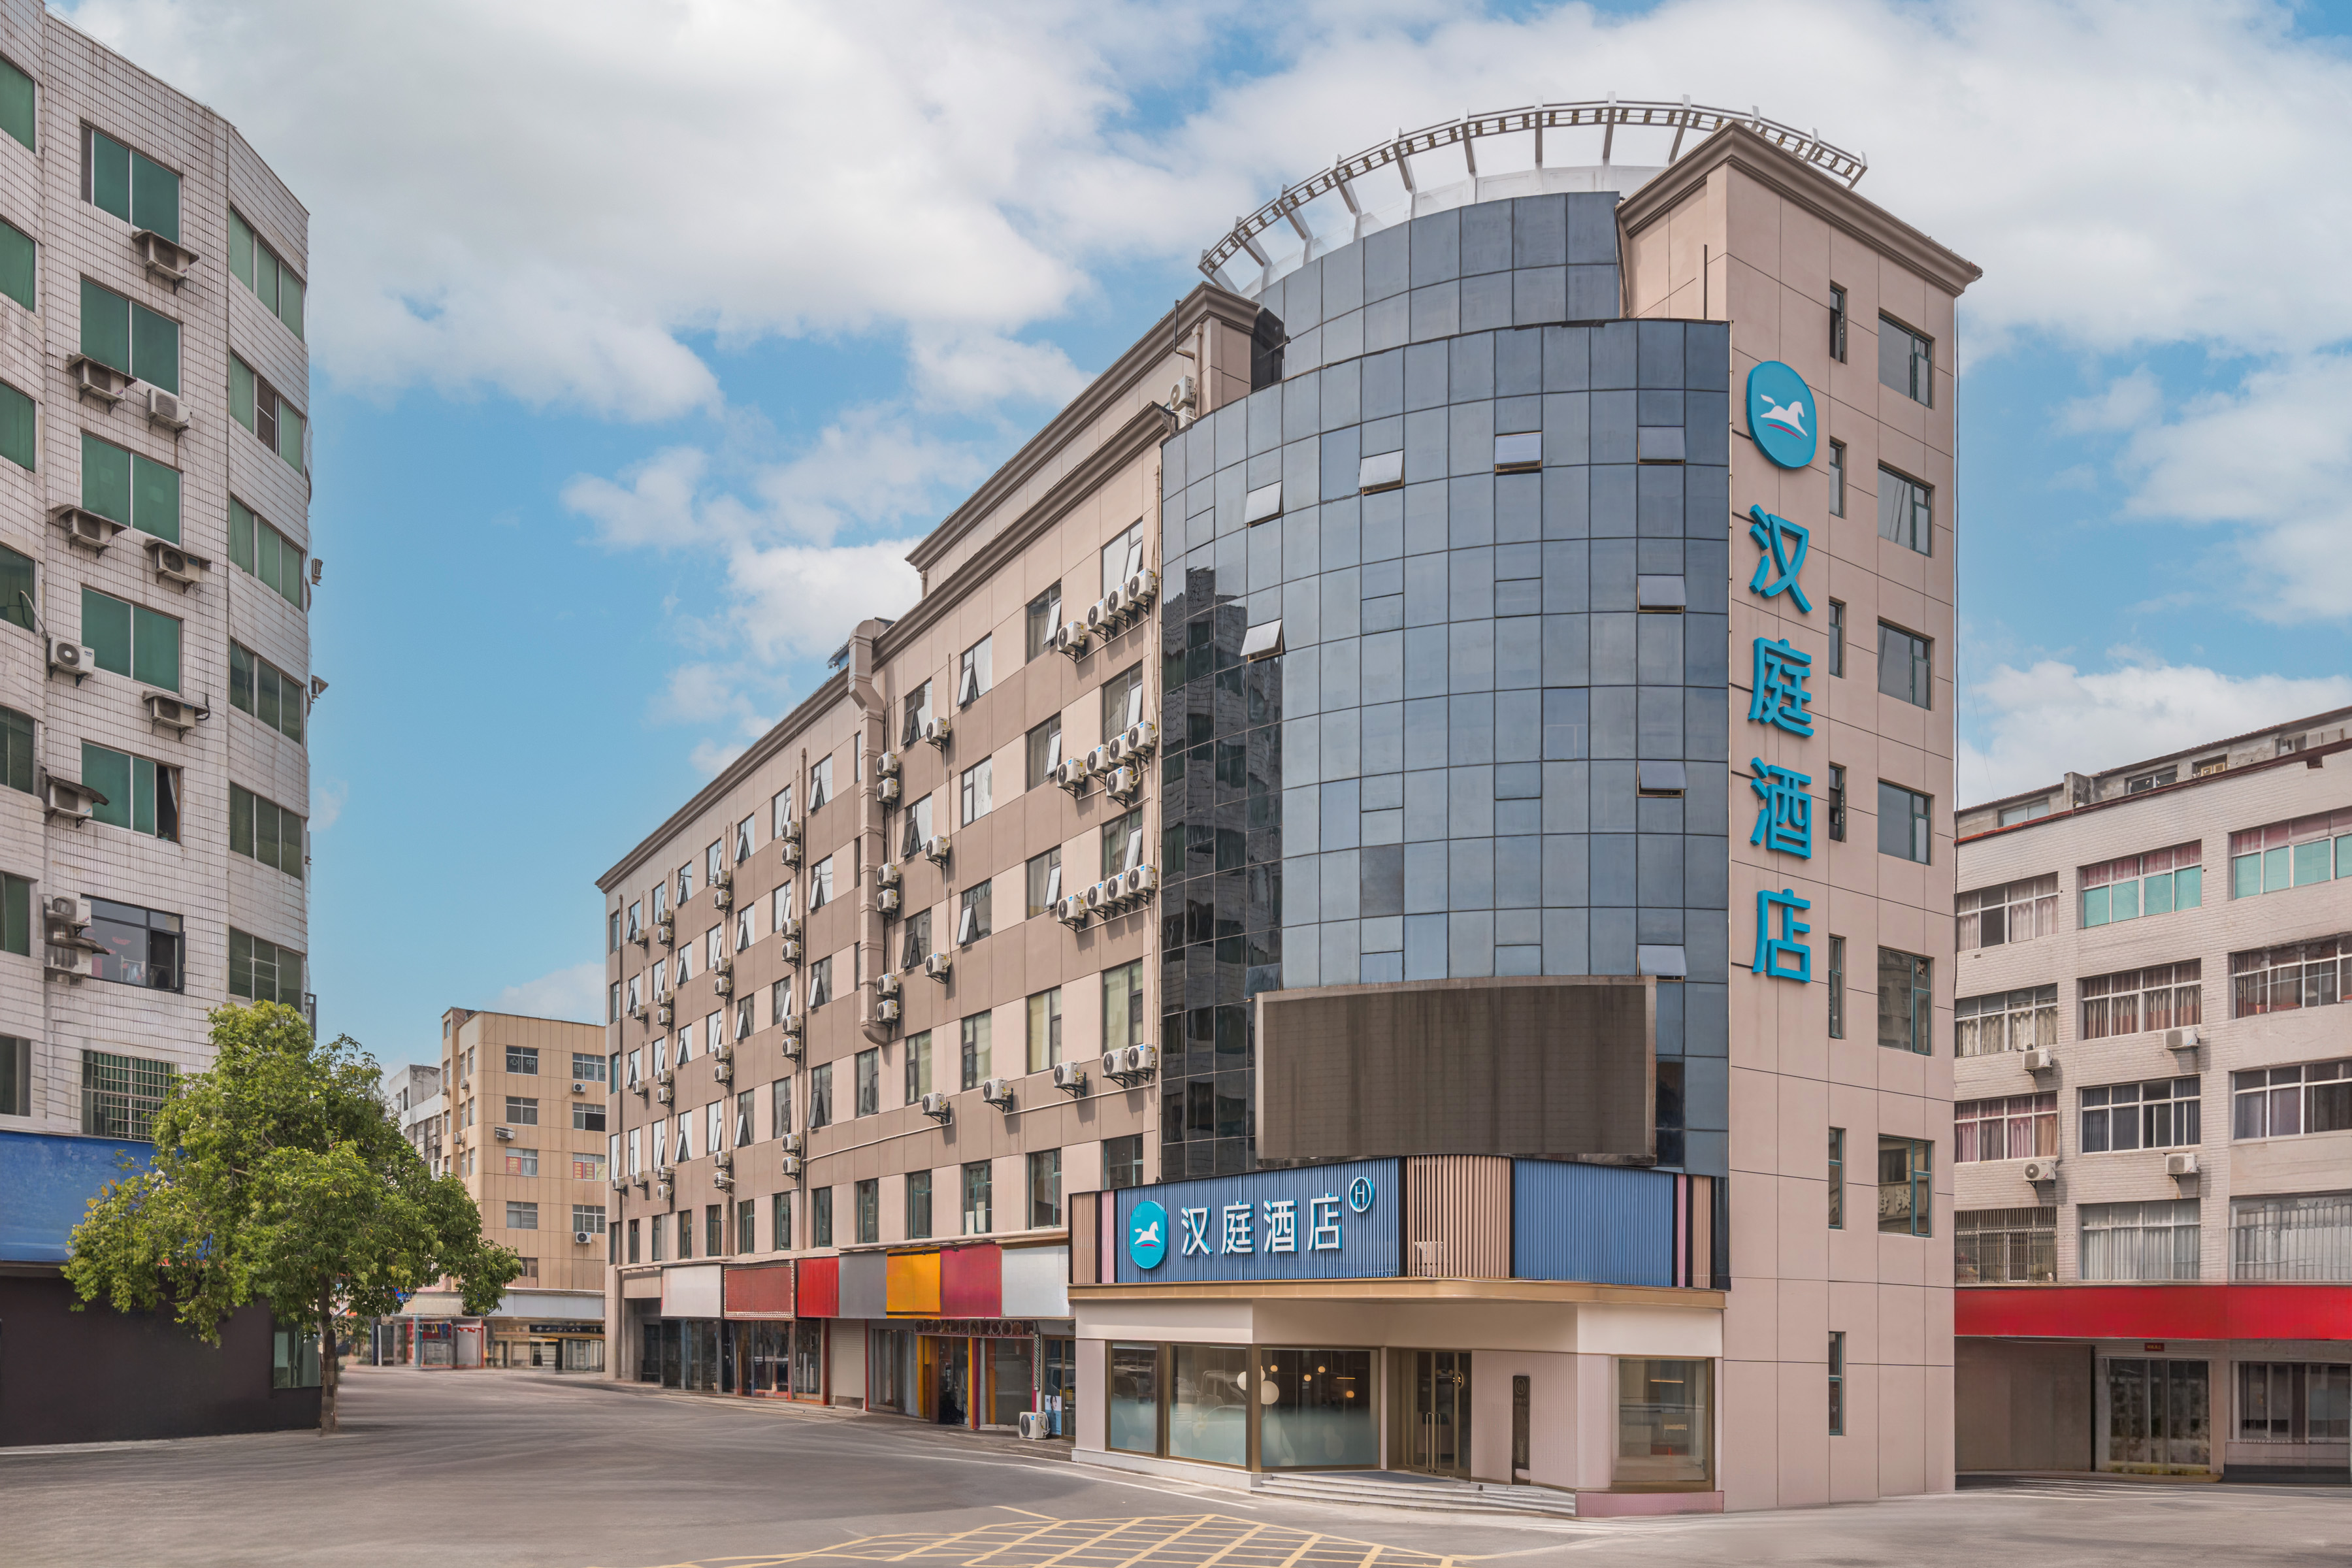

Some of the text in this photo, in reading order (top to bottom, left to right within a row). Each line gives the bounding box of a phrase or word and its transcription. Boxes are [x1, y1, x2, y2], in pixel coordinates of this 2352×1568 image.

[1748, 504, 1814, 984] 汉庭酒店
[1181, 1193, 1343, 1254] 汉庭酒店
